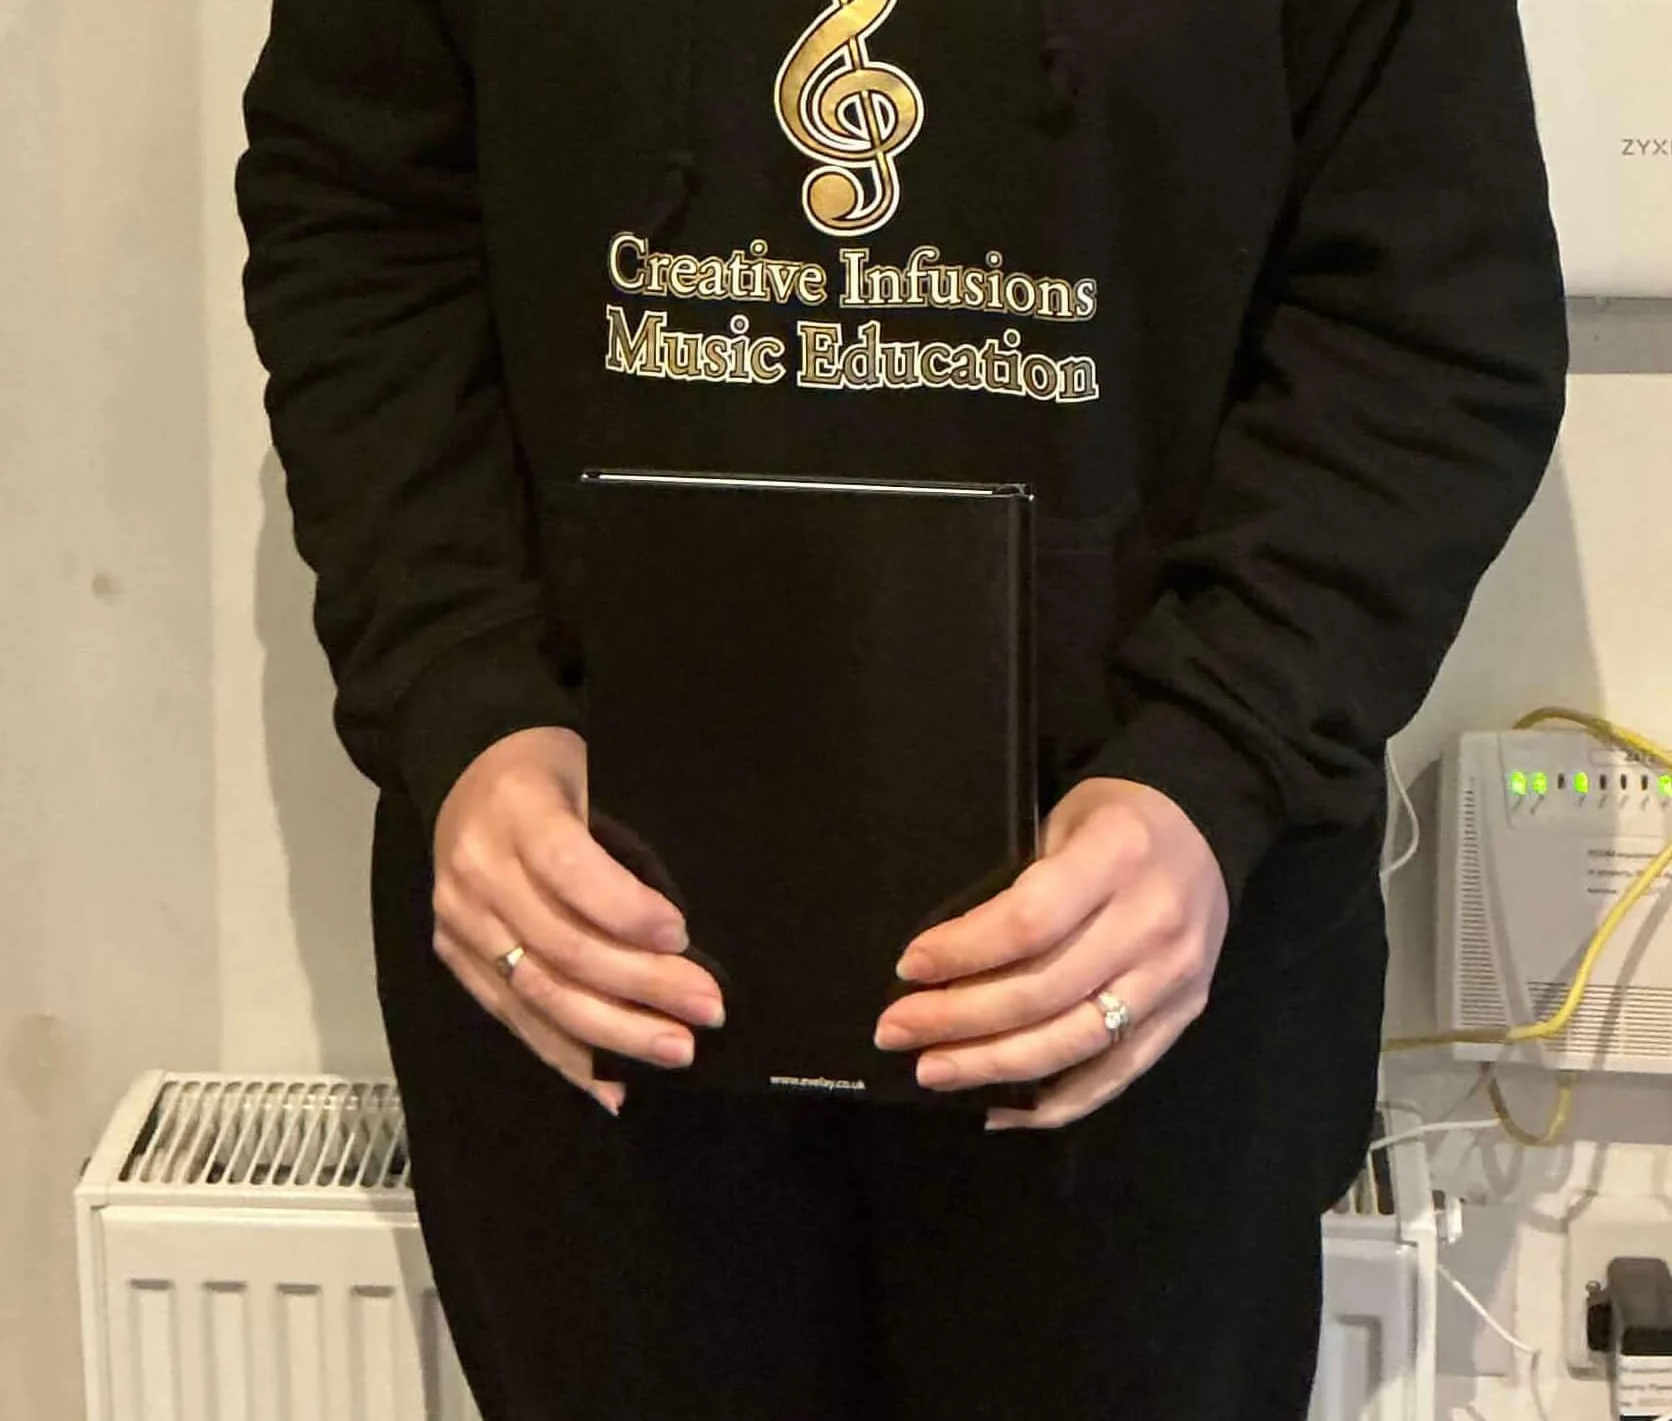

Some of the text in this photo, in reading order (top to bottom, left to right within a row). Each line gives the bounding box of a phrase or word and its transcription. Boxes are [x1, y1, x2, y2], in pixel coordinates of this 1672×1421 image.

[1621, 138, 1672, 156] ZYX
[609, 232, 1097, 322] Creative Infusions
[605, 304, 1099, 404] Music Education
